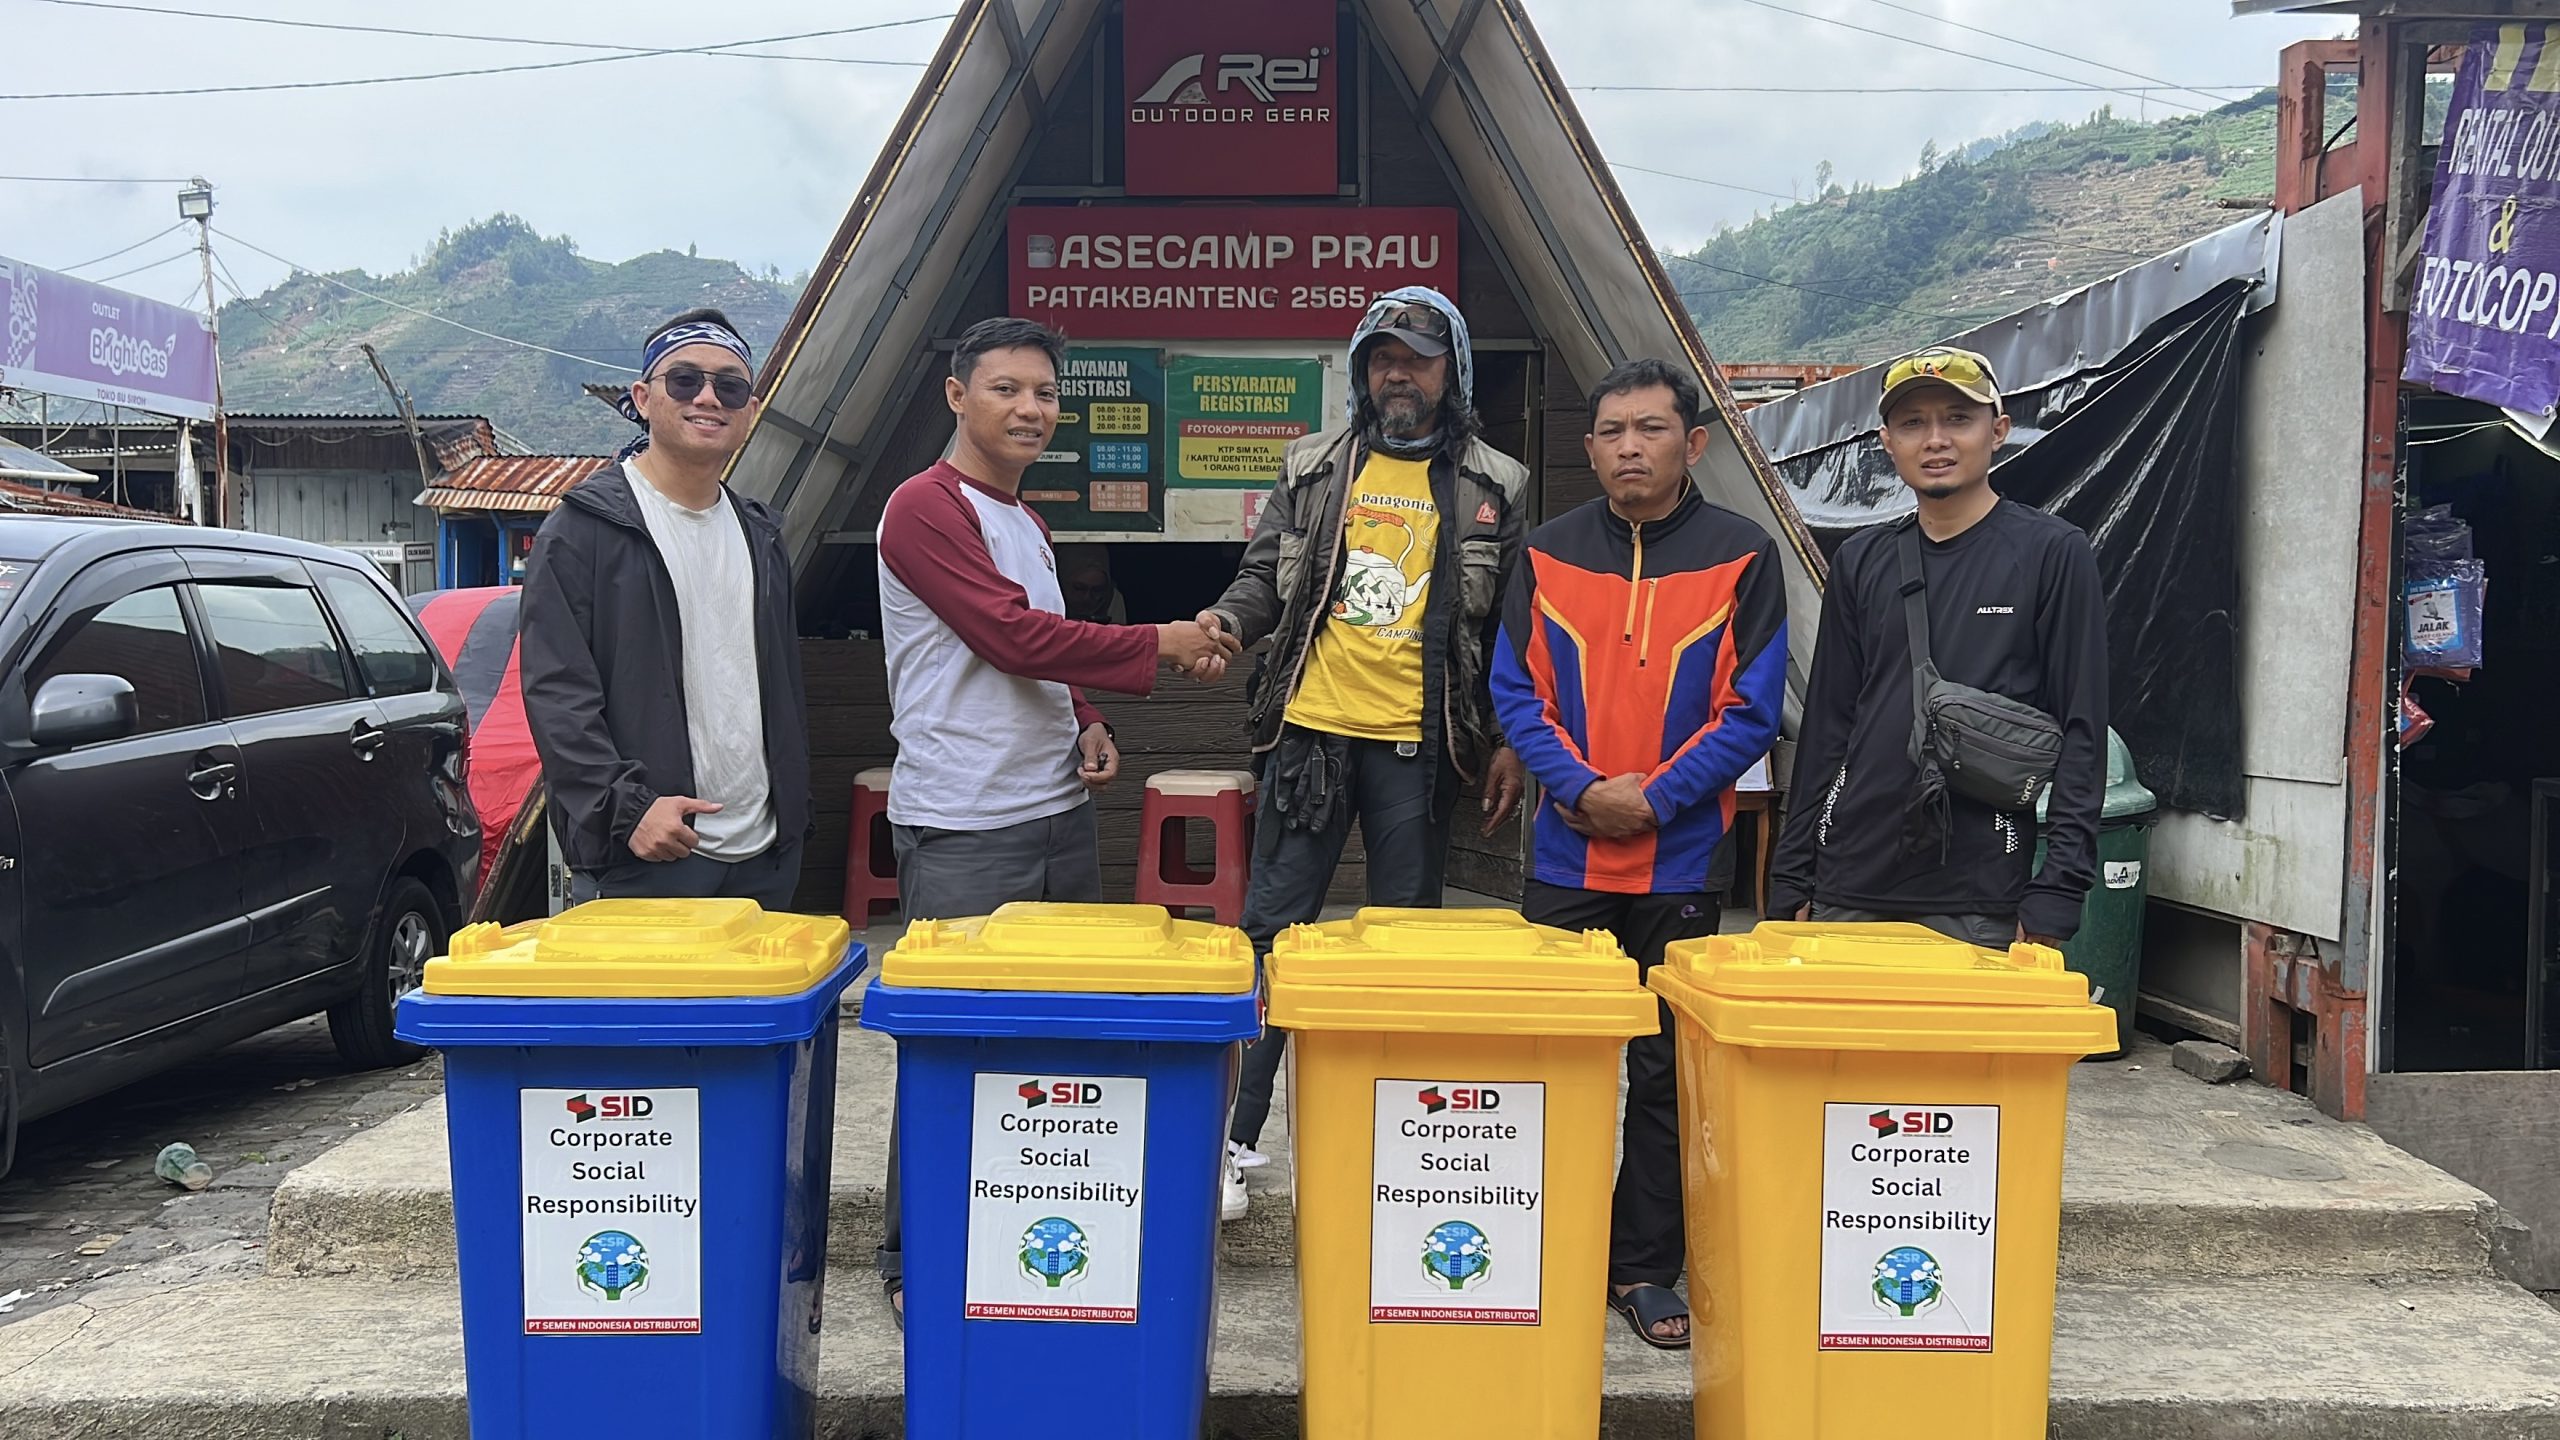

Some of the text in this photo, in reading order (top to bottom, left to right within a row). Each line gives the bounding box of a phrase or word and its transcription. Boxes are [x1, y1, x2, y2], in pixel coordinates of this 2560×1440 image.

[1217, 47, 1321, 102] Rei
[1131, 107, 1330, 123] OUTDOOR GEAR
[2448, 108, 2523, 176] RENTAL
[2488, 195, 2517, 253] &
[1311, 235, 1440, 269] PRAU
[1290, 287, 1366, 309] 2565
[92, 301, 120, 320] OUTLET
[93, 331, 167, 375] Bright Gas
[1060, 360, 1128, 377] LAYANAN
[1056, 380, 1131, 397] EGISTRASI
[1193, 375, 1297, 394] PERSYARATAN
[97, 389, 115, 401] TOKO
[1200, 394, 1289, 413] REGISTRASI
[1187, 424, 1301, 436] FOTOKOPY IDENTITAS
[1190, 454, 1220, 462] KARTU
[1221, 455, 1264, 463] IDENTITAS
[1236, 446, 1252, 454] SIM
[1209, 464, 1240, 472] ORANG
[1361, 493, 1435, 513] patagonia
[2418, 621, 2449, 633] JALAK
[2016, 775, 2037, 804] torch
[1051, 1082, 1102, 1105] SID
[1451, 1088, 1500, 1110] SID
[600, 1095, 654, 1117] SID
[1000, 1113, 1119, 1137] Corporate
[1401, 1119, 1517, 1143] Corporate
[1902, 1111, 1954, 1134] SID
[550, 1128, 673, 1151] Corporate
[1020, 1147, 1089, 1168] Social
[1420, 1152, 1490, 1172] Social
[1851, 1143, 1970, 1167] Corporate
[572, 1161, 645, 1181] Social
[974, 1179, 1139, 1207] Responsibility
[1376, 1184, 1539, 1210] Responsibility
[1871, 1177, 1942, 1197] Social
[527, 1194, 697, 1218] Responsibility
[1042, 1223, 1067, 1235] CSR
[1444, 1226, 1469, 1238] CSR
[1826, 1210, 1991, 1235] Responsibility
[600, 1236, 625, 1248] CSR
[1895, 1252, 1921, 1264] CSR
[969, 1305, 1134, 1318] PT SEMEN INDONESIA DISTRIBUTOR
[1373, 1308, 1536, 1320] PT SEMEN INDONESIA DISTRIBUTOR
[528, 1320, 697, 1330] PT SEMEN INDONESIA DISTRIBUTOR
[1823, 1336, 1987, 1347] PT SEMEN INDONESIA DISTRIBUTOR
